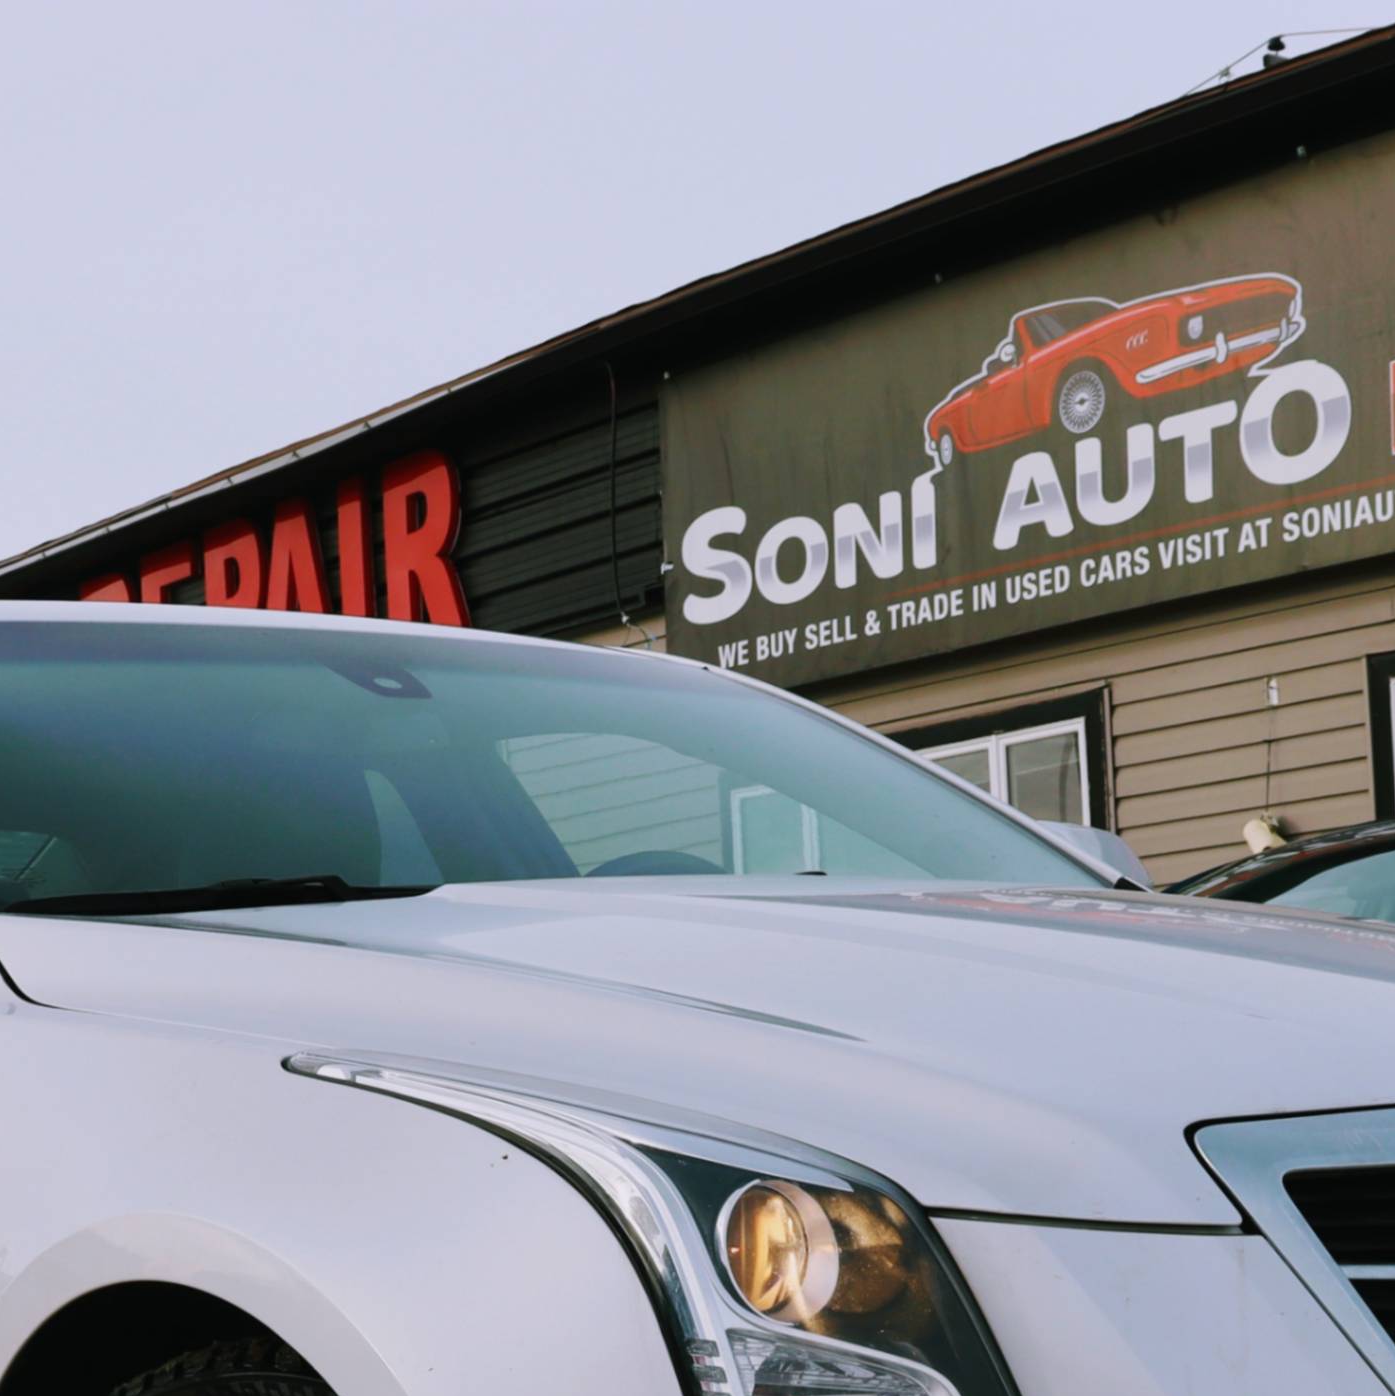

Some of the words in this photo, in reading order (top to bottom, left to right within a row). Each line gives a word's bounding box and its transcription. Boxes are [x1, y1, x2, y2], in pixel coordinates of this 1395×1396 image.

[993, 358, 1352, 550] AUTO
[717, 640, 750, 669] WE
[756, 628, 799, 662] BUY
[805, 618, 858, 650] SELL
[864, 610, 881, 637] &
[887, 590, 964, 631] TRADE
[973, 581, 997, 611] IN
[1006, 564, 1071, 604] USED
[1080, 547, 1151, 586] CARS
[1158, 527, 1229, 571] VISIT
[1238, 518, 1272, 554] AT
